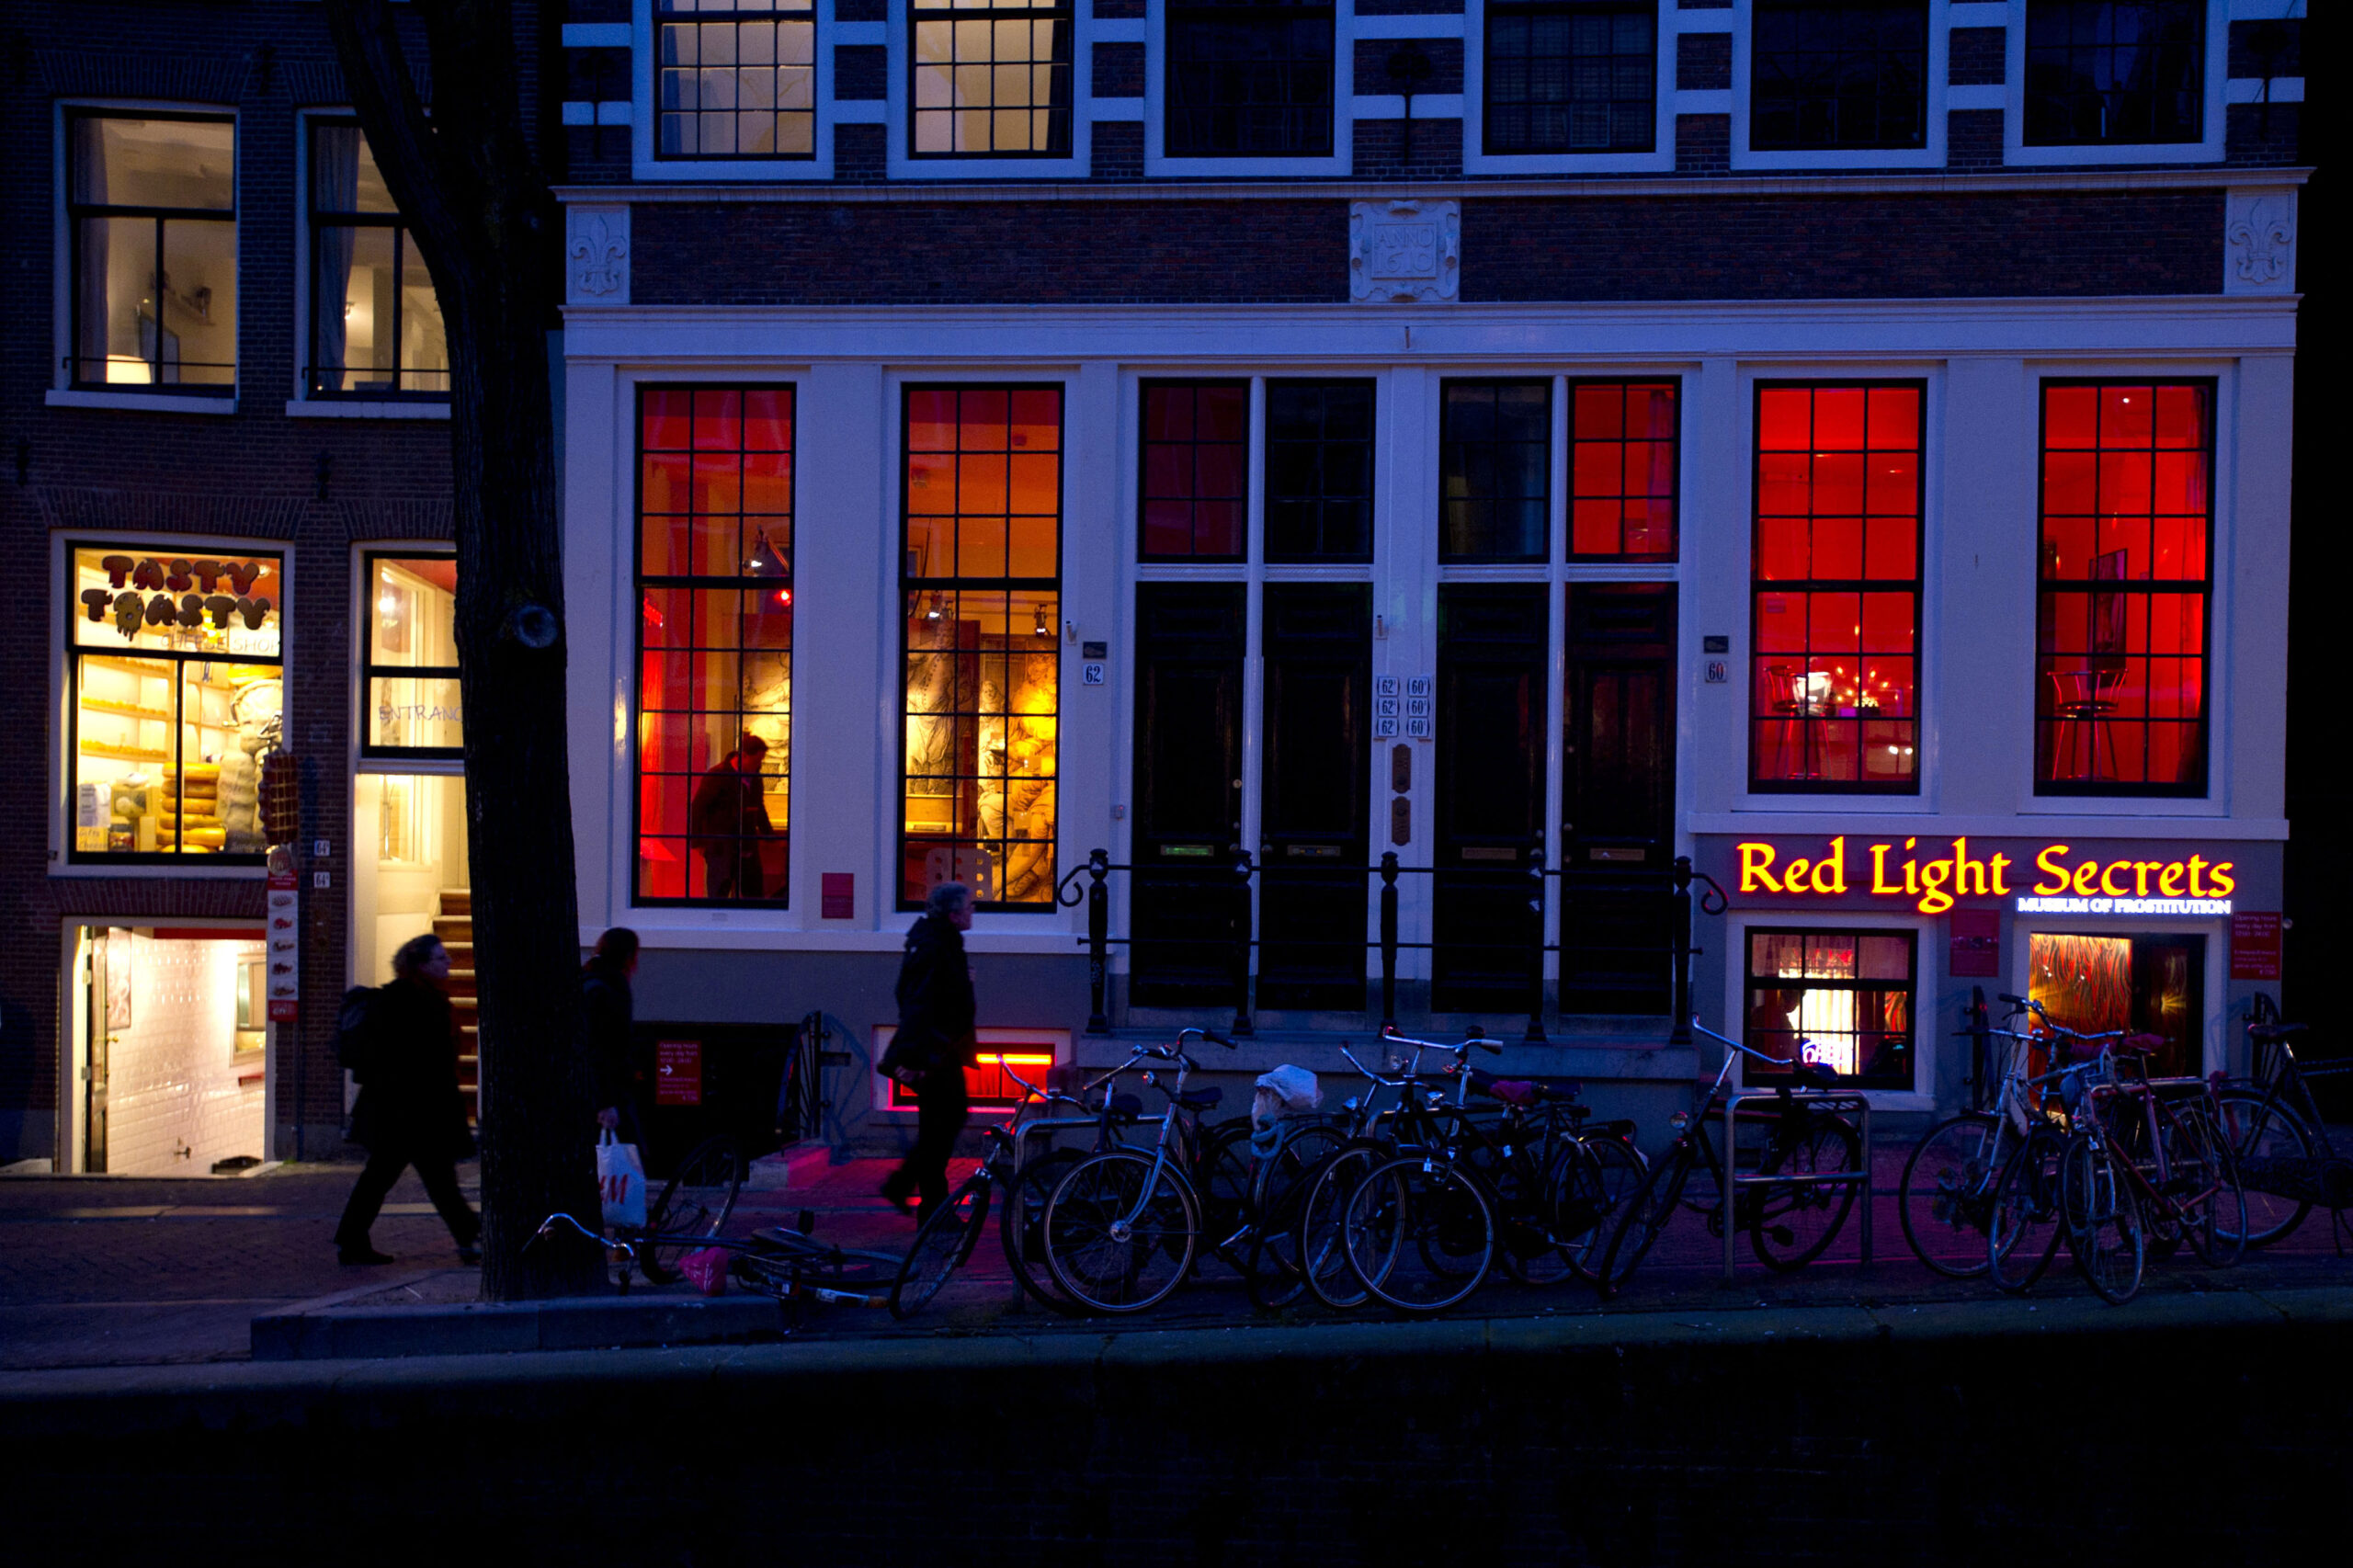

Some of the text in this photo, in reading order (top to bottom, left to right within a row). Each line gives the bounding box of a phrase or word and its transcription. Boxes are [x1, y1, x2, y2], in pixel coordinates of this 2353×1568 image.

[1374, 226, 1435, 248] ANNO
[1374, 251, 1435, 274] 1610
[101, 554, 260, 596] TASTY
[1086, 665, 1101, 683] 62
[1709, 662, 1724, 681] 60
[379, 704, 463, 722] ENTRANC
[1735, 835, 2235, 914] Red Light Secrets
[2018, 897, 2232, 915] MUSEUM OF PROSTITUTION
